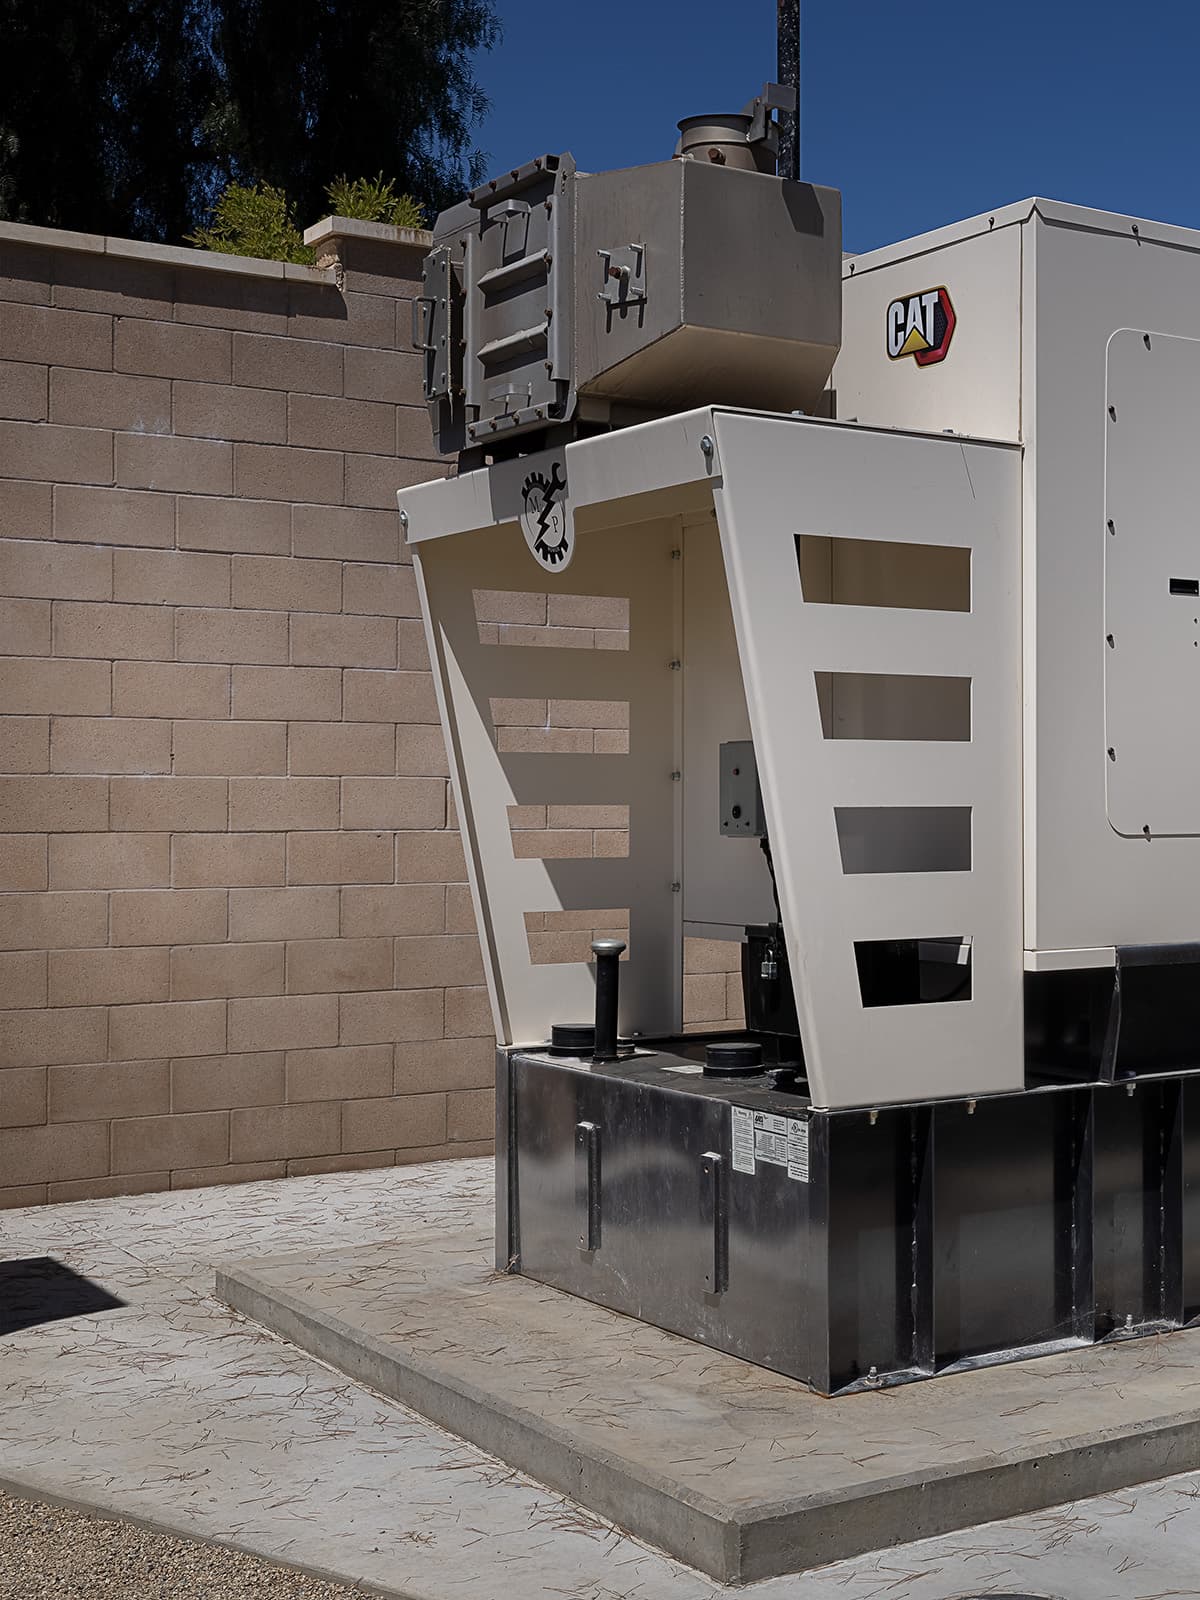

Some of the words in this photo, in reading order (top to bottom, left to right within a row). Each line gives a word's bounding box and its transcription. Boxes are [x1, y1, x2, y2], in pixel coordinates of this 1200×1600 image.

[888, 291, 939, 357] CAT
[528, 495, 541, 514] M
[551, 516, 559, 533] P
